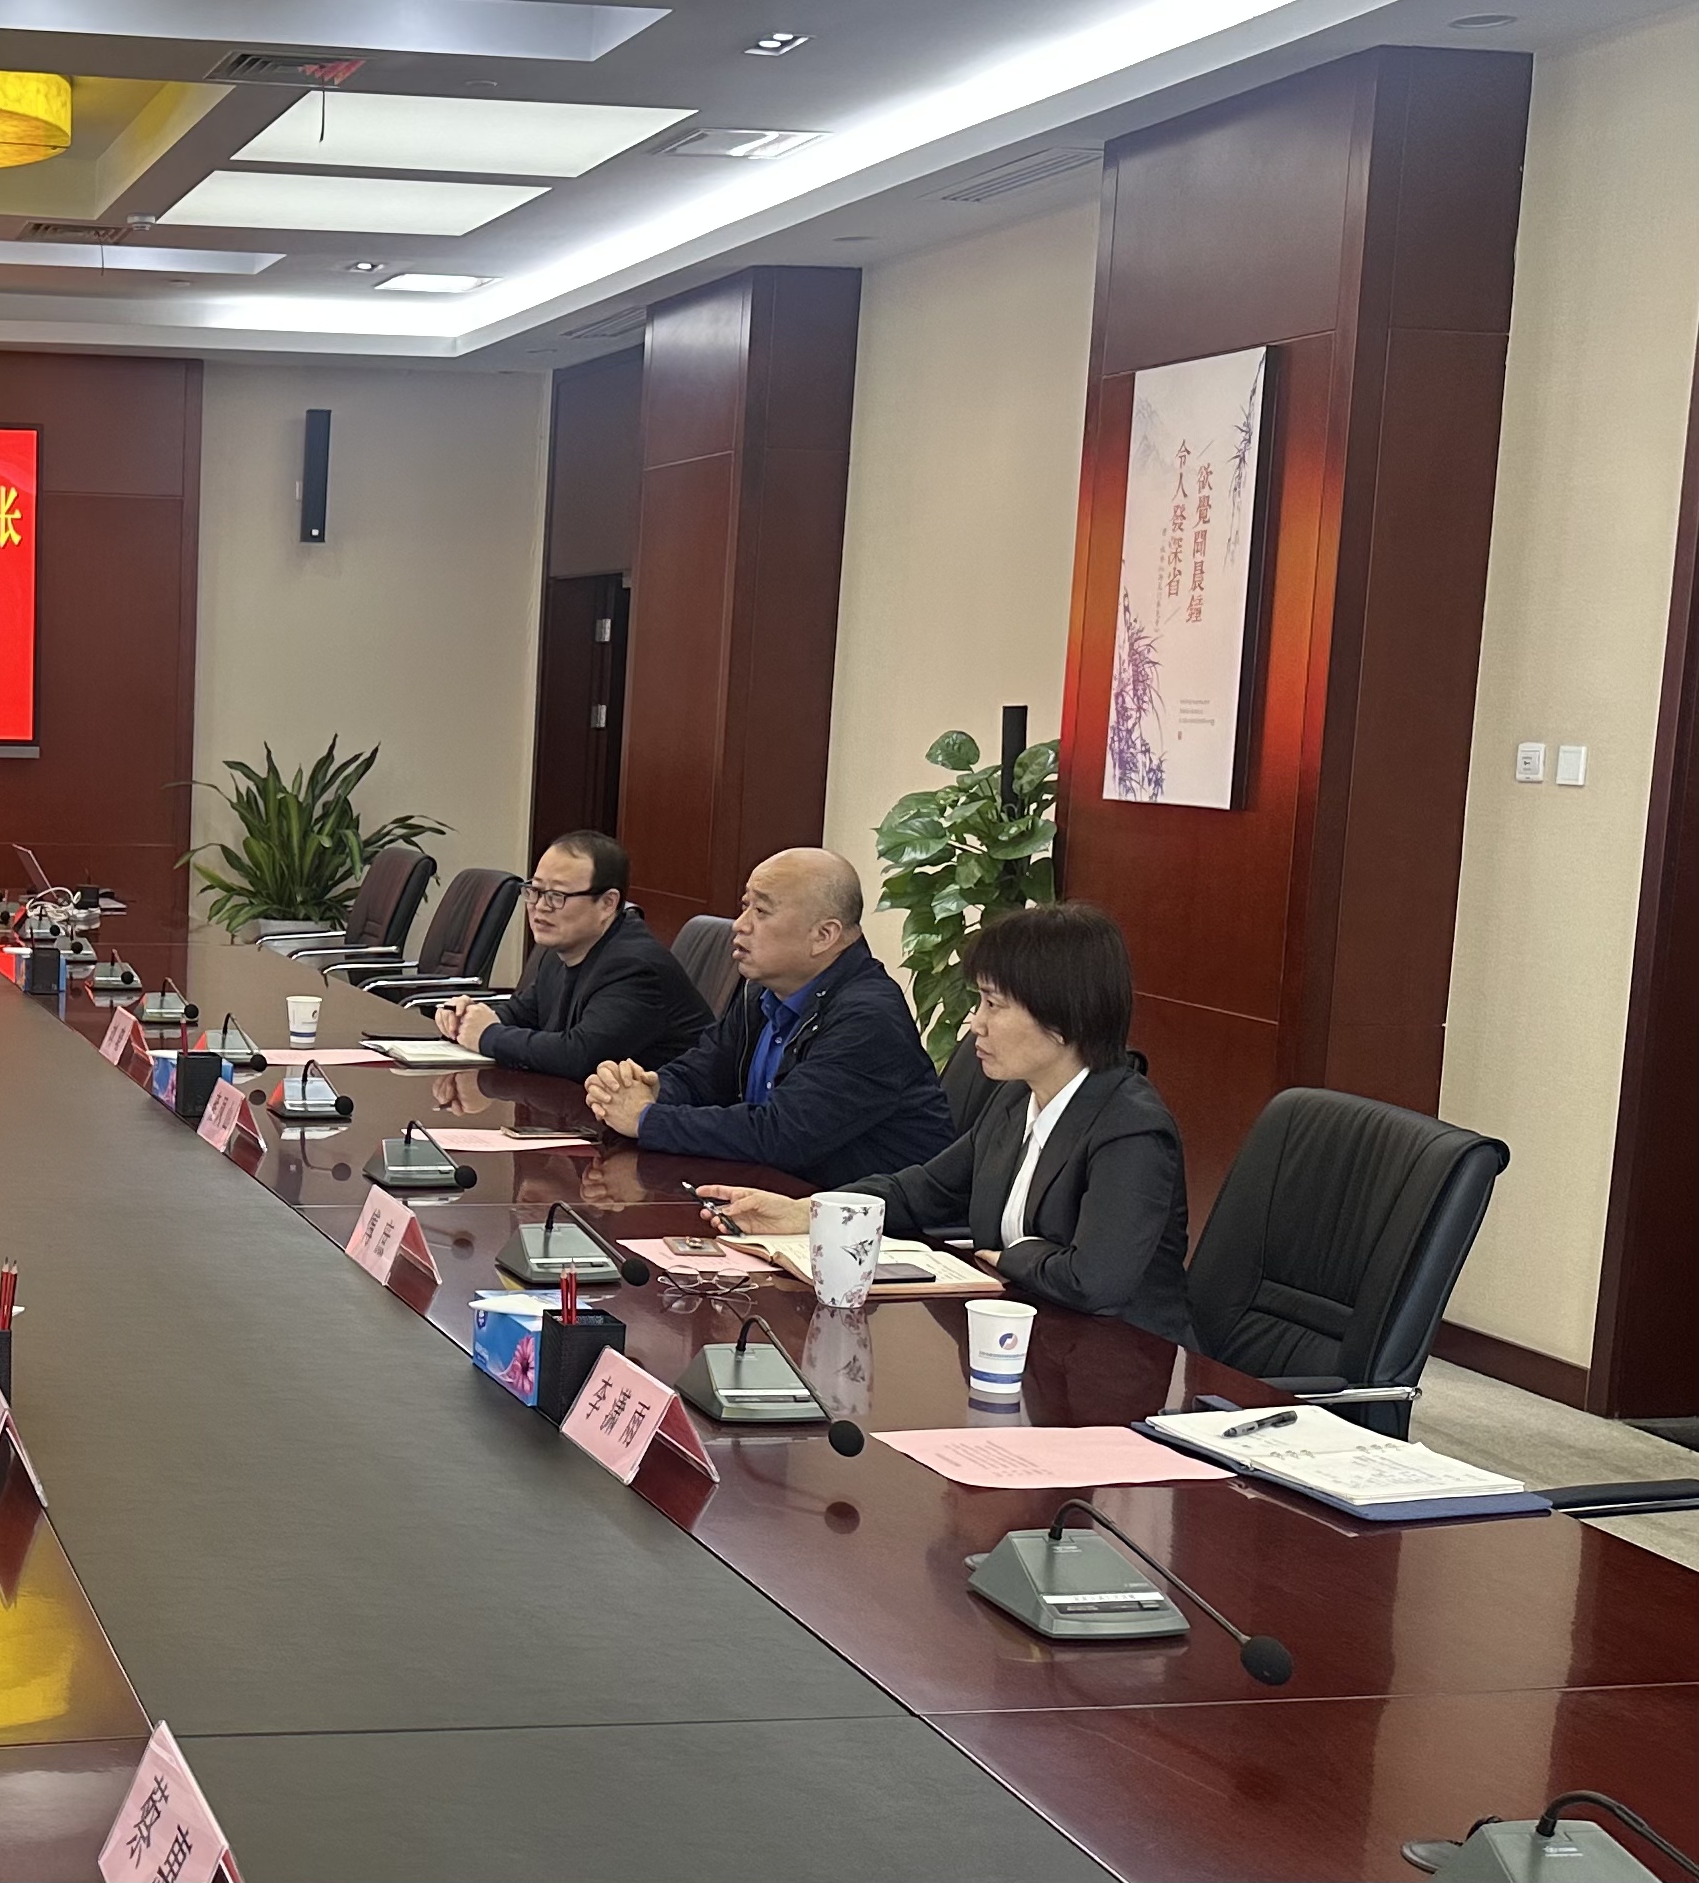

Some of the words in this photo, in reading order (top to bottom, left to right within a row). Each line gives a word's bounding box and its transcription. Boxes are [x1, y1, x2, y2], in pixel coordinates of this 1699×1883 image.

[1166, 439, 1191, 598] 令人發深省
[585, 1375, 652, 1449] 李潇雨
